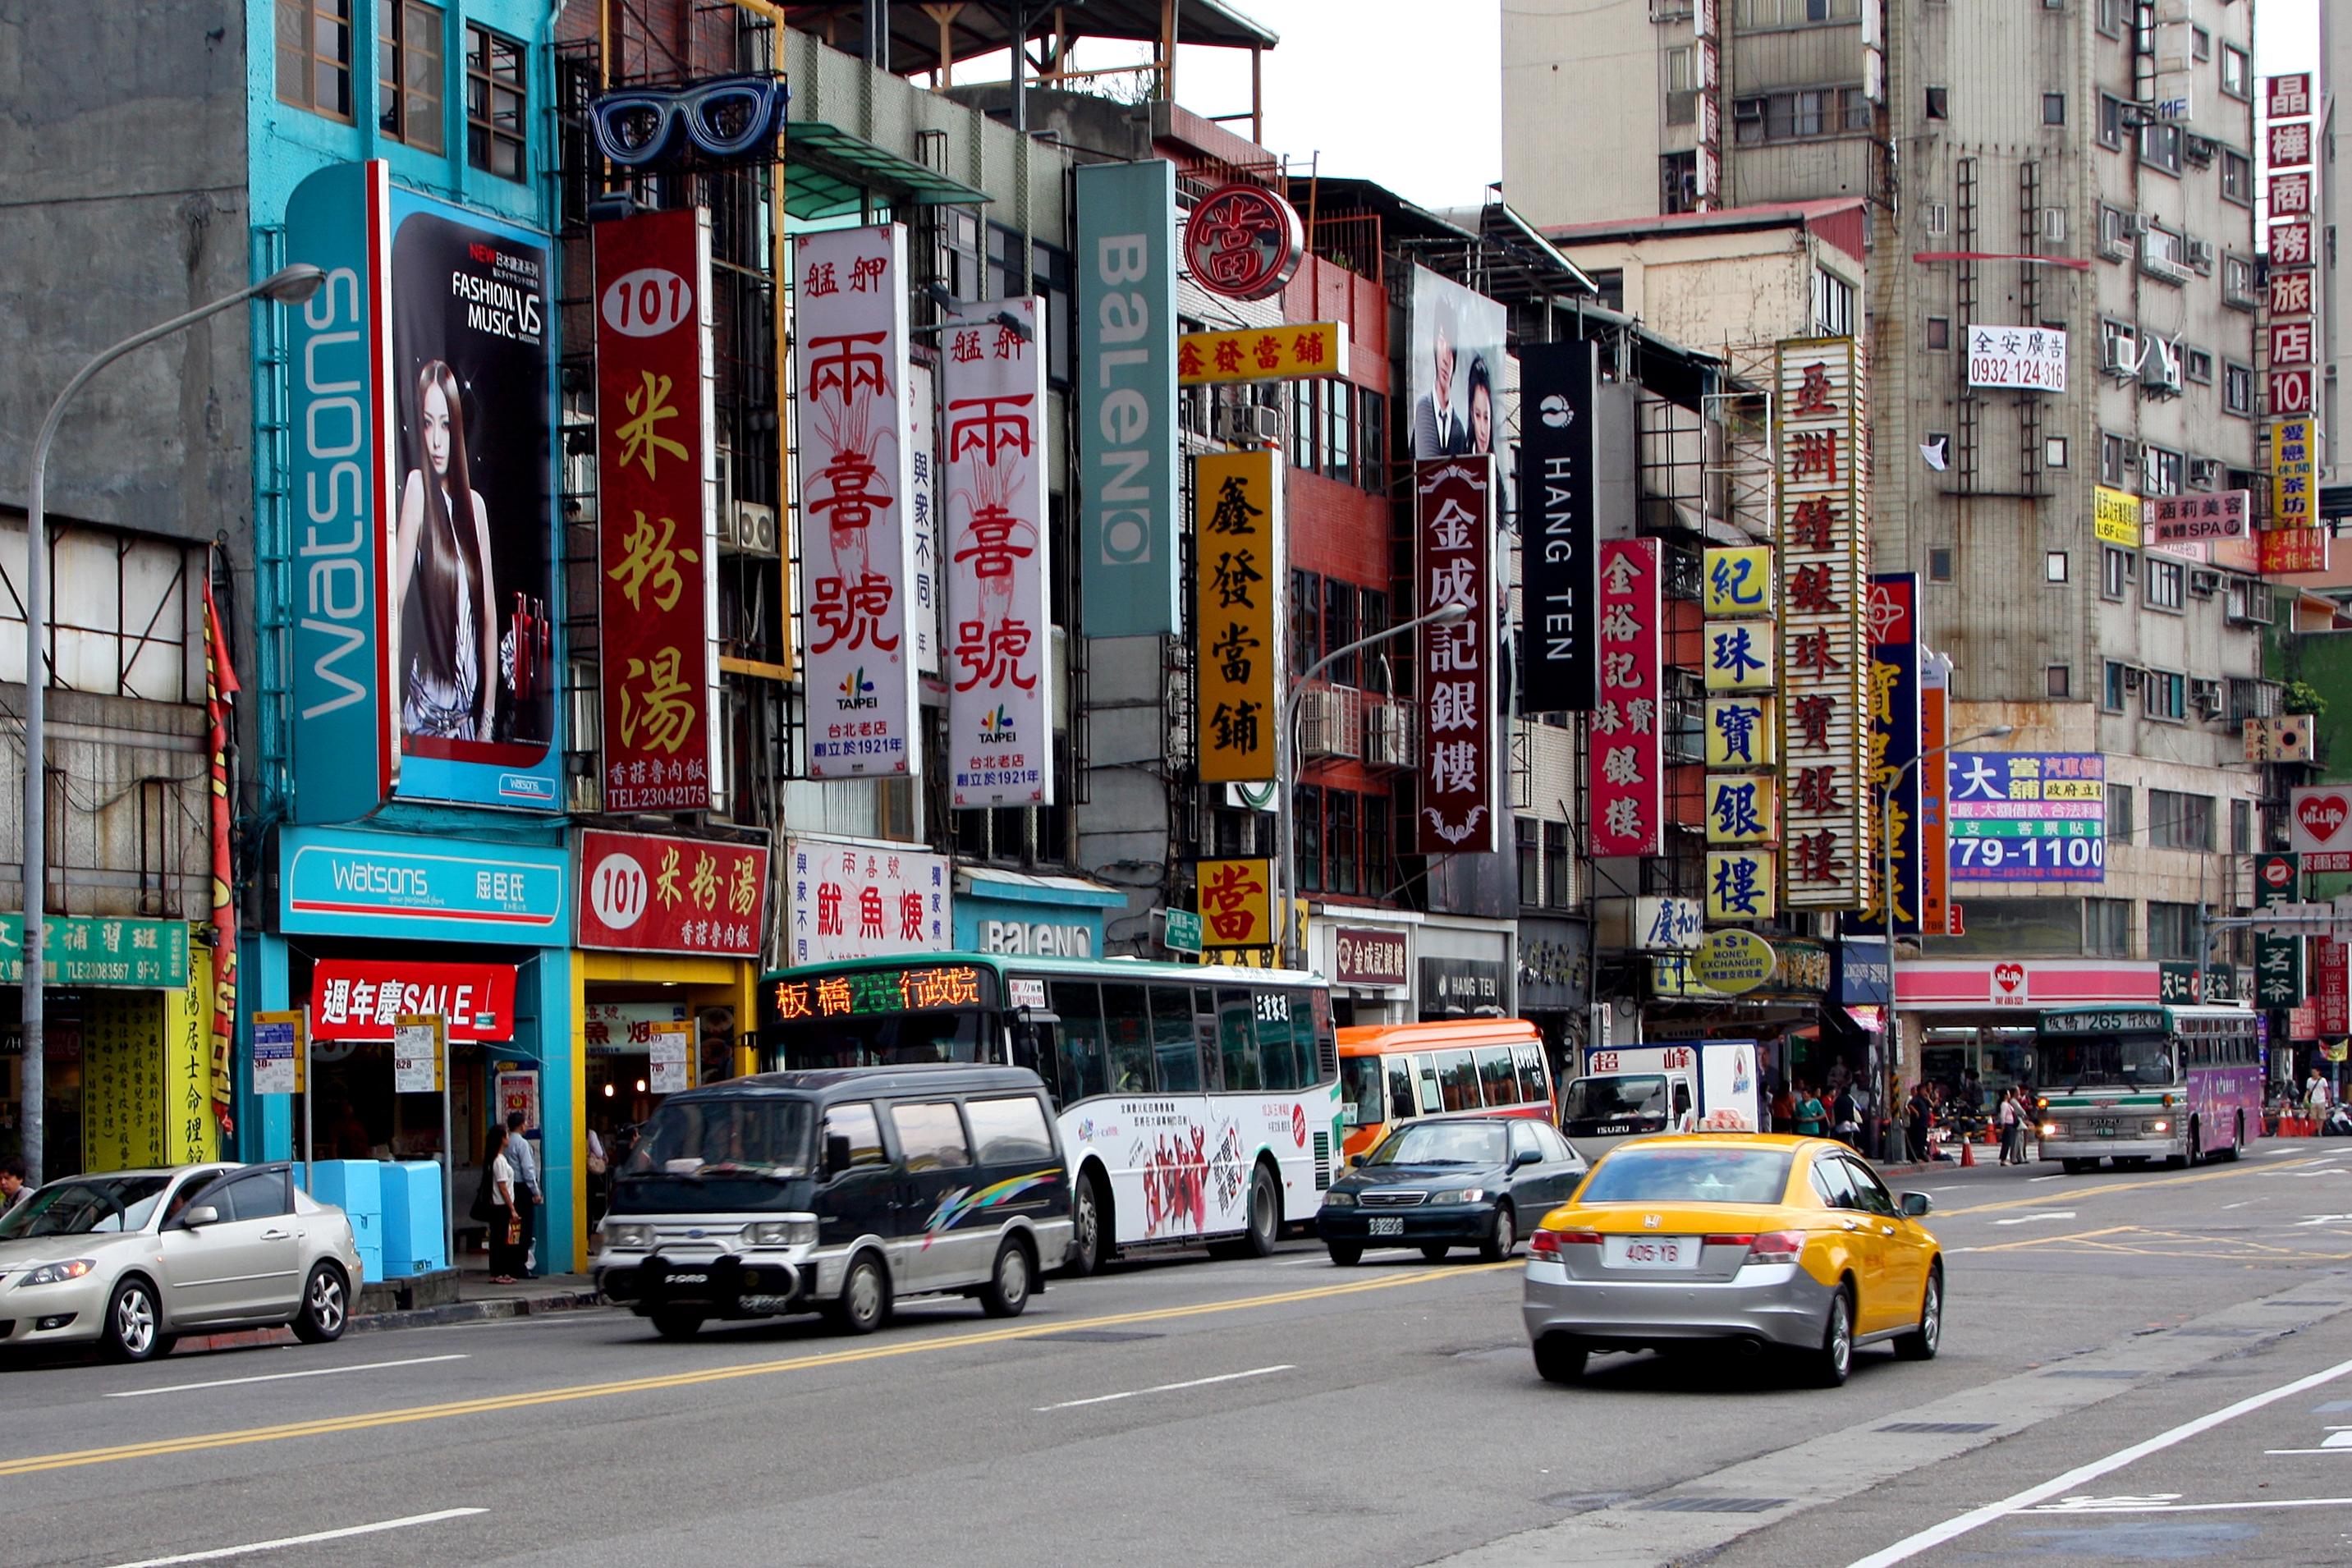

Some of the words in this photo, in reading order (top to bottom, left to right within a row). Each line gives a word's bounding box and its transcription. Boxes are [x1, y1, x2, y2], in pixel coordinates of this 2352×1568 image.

[2158, 97, 2187, 121] 11F
[2271, 76, 2308, 364] 晶樺商務旅店
[468, 242, 496, 264] NEW
[1199, 195, 1277, 284] 當
[803, 254, 887, 299] 艋舺
[515, 288, 542, 336] VS
[617, 277, 682, 328] 101
[951, 328, 1026, 364] 艋舺
[1974, 329, 2064, 359] 全安廣告
[1971, 358, 2063, 388] 0932-124-316
[2272, 376, 2311, 411] 10F
[807, 330, 900, 655] 兩喜號
[2281, 477, 2306, 515] 茶坊
[1545, 456, 1572, 564] HANG
[2159, 496, 2242, 520] 涵莉美容
[948, 392, 1038, 693] 兩喜號
[2189, 520, 2221, 535] SPA
[607, 369, 699, 754] 米粉湯
[1546, 587, 1573, 661] TEN
[1429, 497, 1478, 795] 金成記銀樓
[837, 696, 878, 711] TAIPEI
[828, 720, 887, 739] 台北老店
[978, 731, 1017, 745] TAIPEI
[1710, 556, 1767, 915] 紀珠寶銀樓
[813, 737, 903, 758] 創立於1921年
[970, 754, 1025, 769] 台北老店
[610, 758, 707, 786] 香菇魯肉飯
[956, 770, 1039, 787] 創立於1921年
[608, 786, 706, 809] TEL:23042175
[841, 851, 901, 879] 兩喜號
[476, 870, 525, 902] 屈臣氏
[603, 867, 640, 915] 101
[657, 845, 757, 917] 米粉湯
[931, 865, 942, 952] 獨家煮
[1202, 864, 1263, 942] 當
[681, 919, 750, 949] 香菇魯肉飯
[1354, 940, 1404, 978] 金成記銀樓
[1700, 957, 1763, 970] EXCHANGER
[1712, 949, 1749, 960] MONEY
[774, 977, 852, 1019] 板橋
[850, 972, 903, 1015] 265
[899, 965, 979, 1010] 行政院
[1451, 976, 1476, 997] HANG
[1479, 977, 1496, 997] TEN
[2161, 971, 2188, 999] 天仁
[395, 1026, 409, 1035] 234
[2047, 1015, 2079, 1031] 板橋
[2088, 1013, 2121, 1029] 265
[2126, 1014, 2163, 1029] 行政院
[396, 1059, 412, 1070] 628
[1597, 1124, 1630, 1135] ISUZU
[1625, 1245, 1680, 1263] 405-YB
[665, 1273, 708, 1285] FORD
